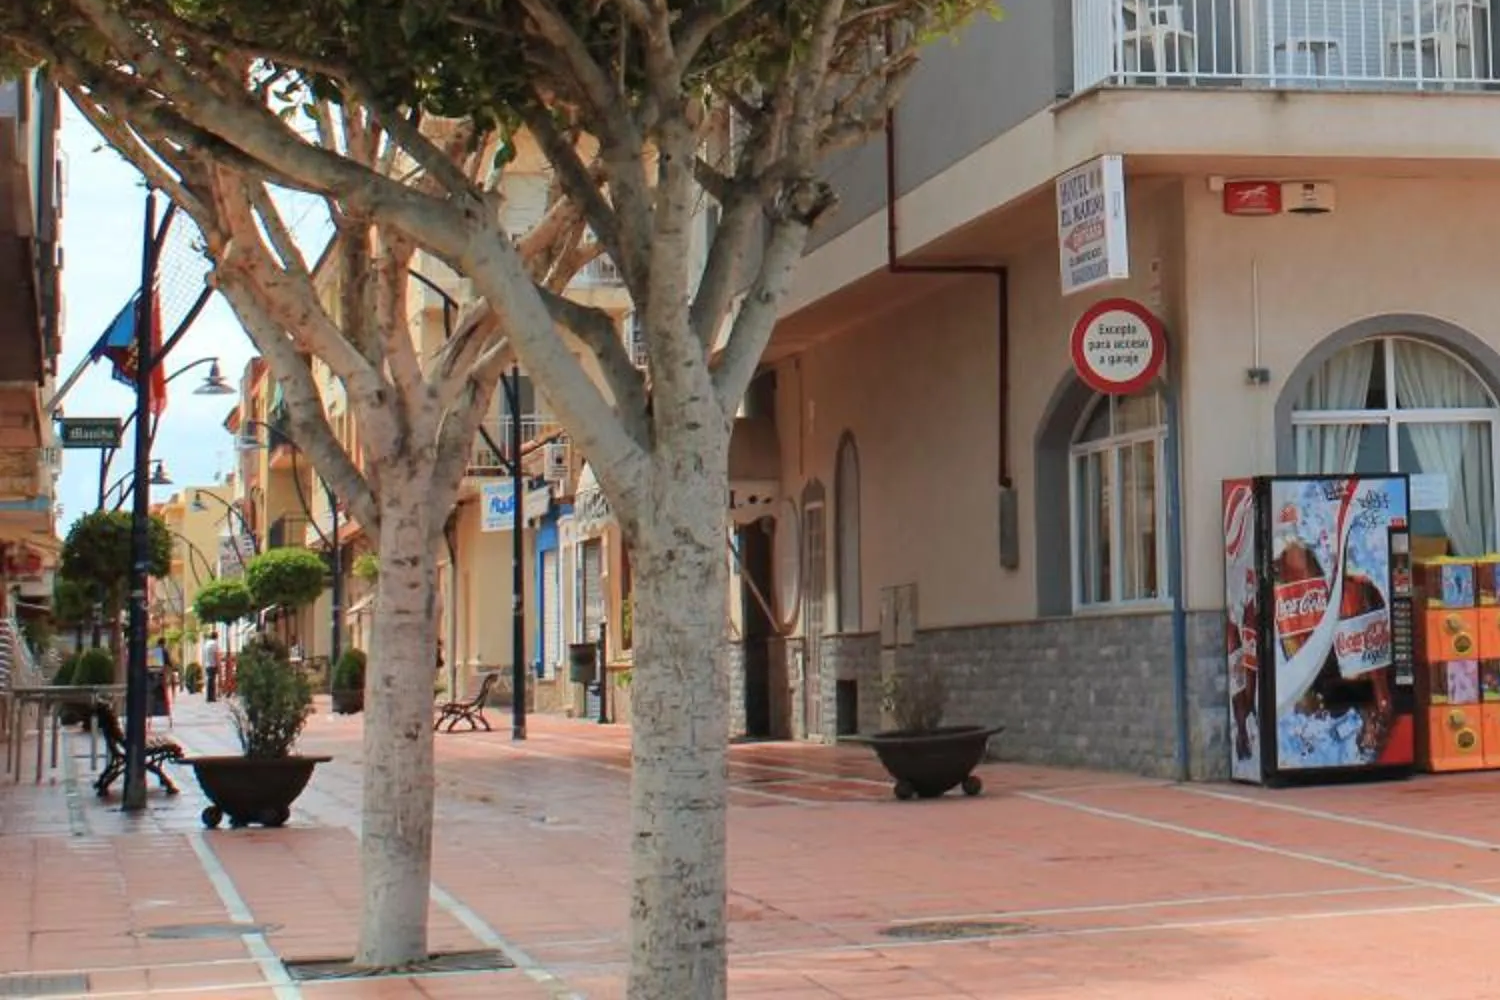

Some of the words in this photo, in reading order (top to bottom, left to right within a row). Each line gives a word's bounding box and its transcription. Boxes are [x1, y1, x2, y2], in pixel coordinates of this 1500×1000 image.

[1098, 322, 1138, 337] Excepto
[1087, 340, 1111, 352] para
[1113, 339, 1149, 350] acceso
[1107, 352, 1139, 367] garaje
